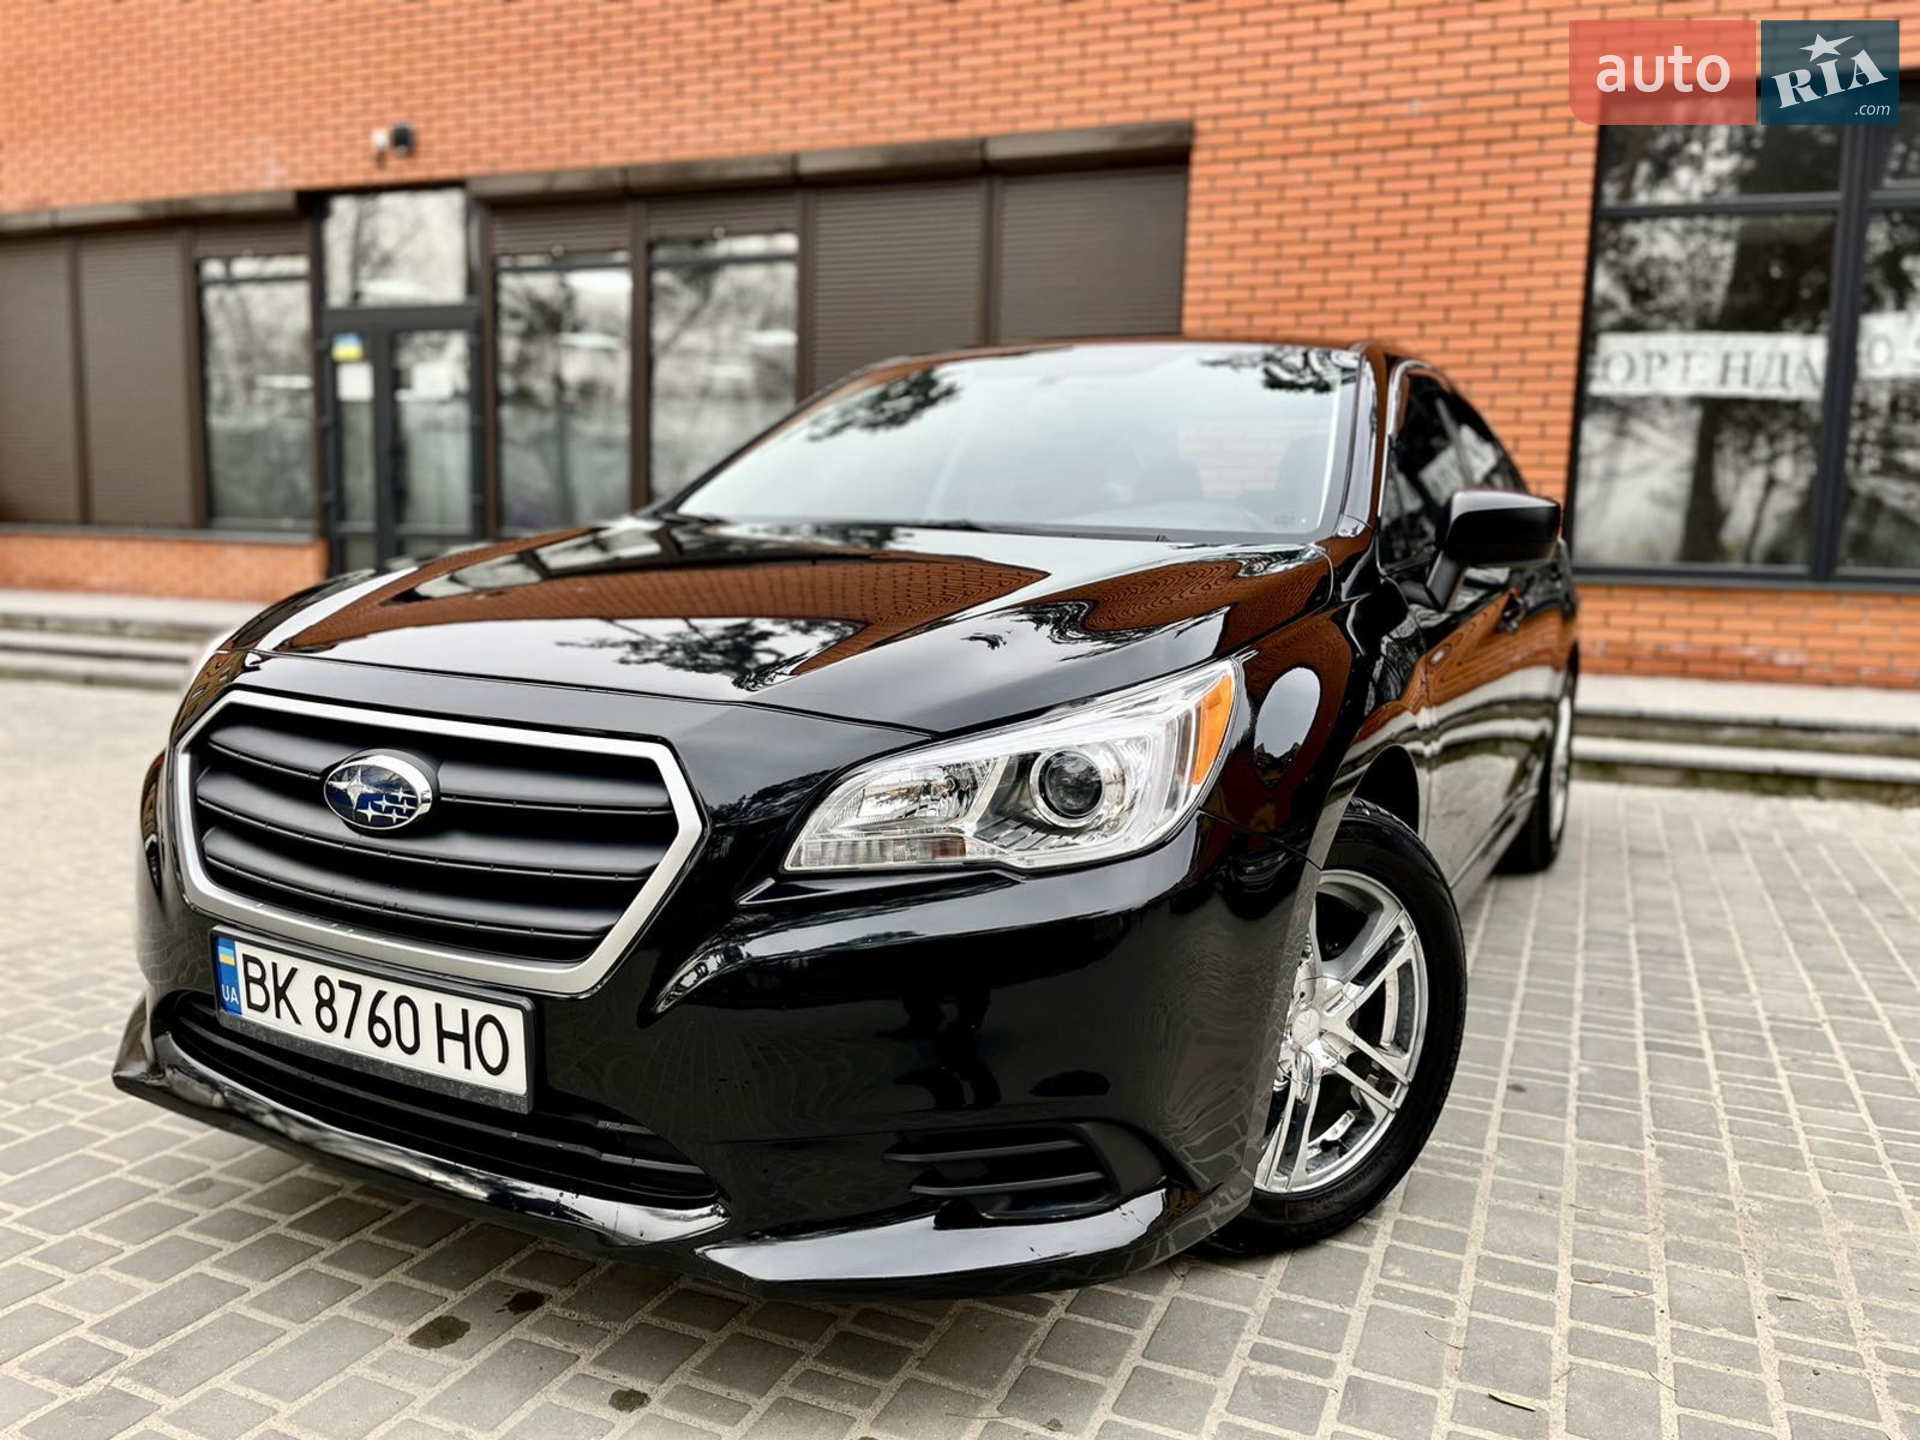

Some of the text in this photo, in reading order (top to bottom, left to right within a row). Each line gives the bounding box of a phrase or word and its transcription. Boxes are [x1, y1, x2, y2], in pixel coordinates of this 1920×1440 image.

[221, 984, 239, 1004] UA
[242, 953, 509, 1076] BK 8760 HO
